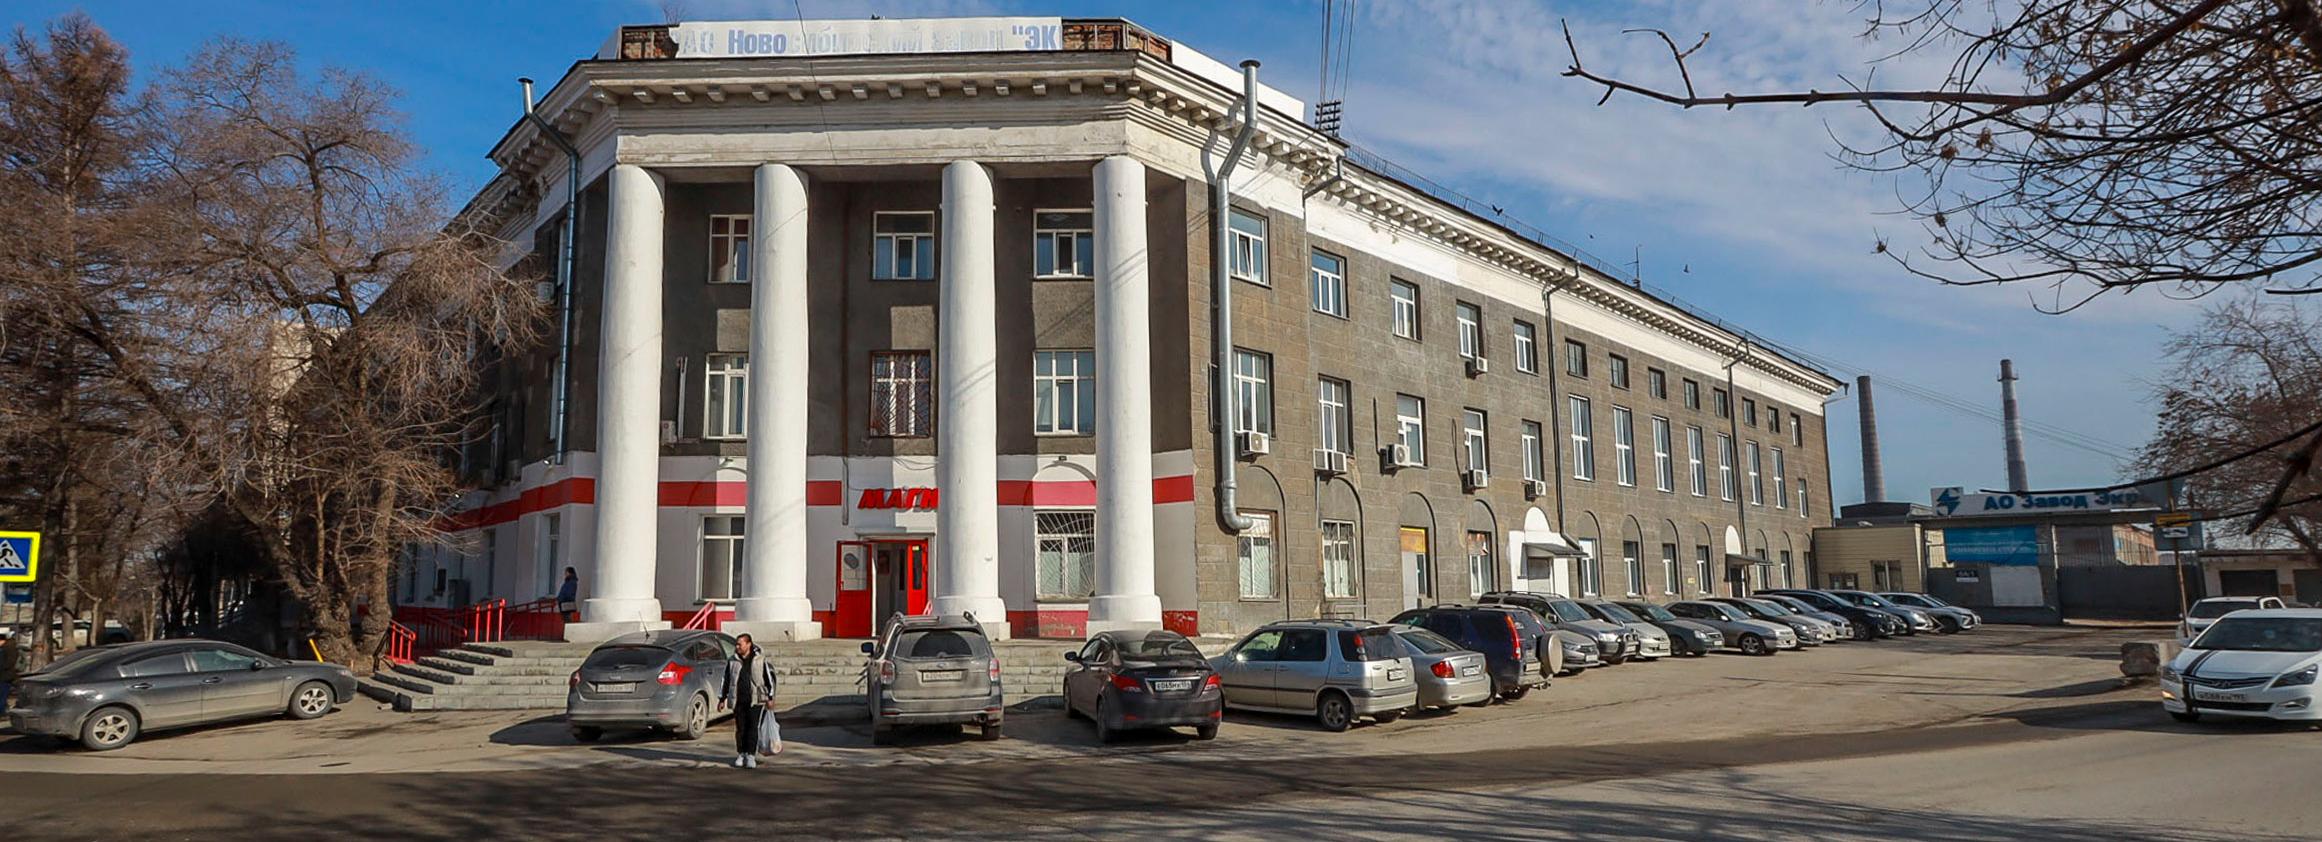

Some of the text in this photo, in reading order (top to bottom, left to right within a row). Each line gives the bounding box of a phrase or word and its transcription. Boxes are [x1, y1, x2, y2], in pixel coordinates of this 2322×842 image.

[1011, 24, 1062, 51] "ЭК
[1983, 496, 2015, 511] АО
[2020, 493, 2089, 510] Завод
